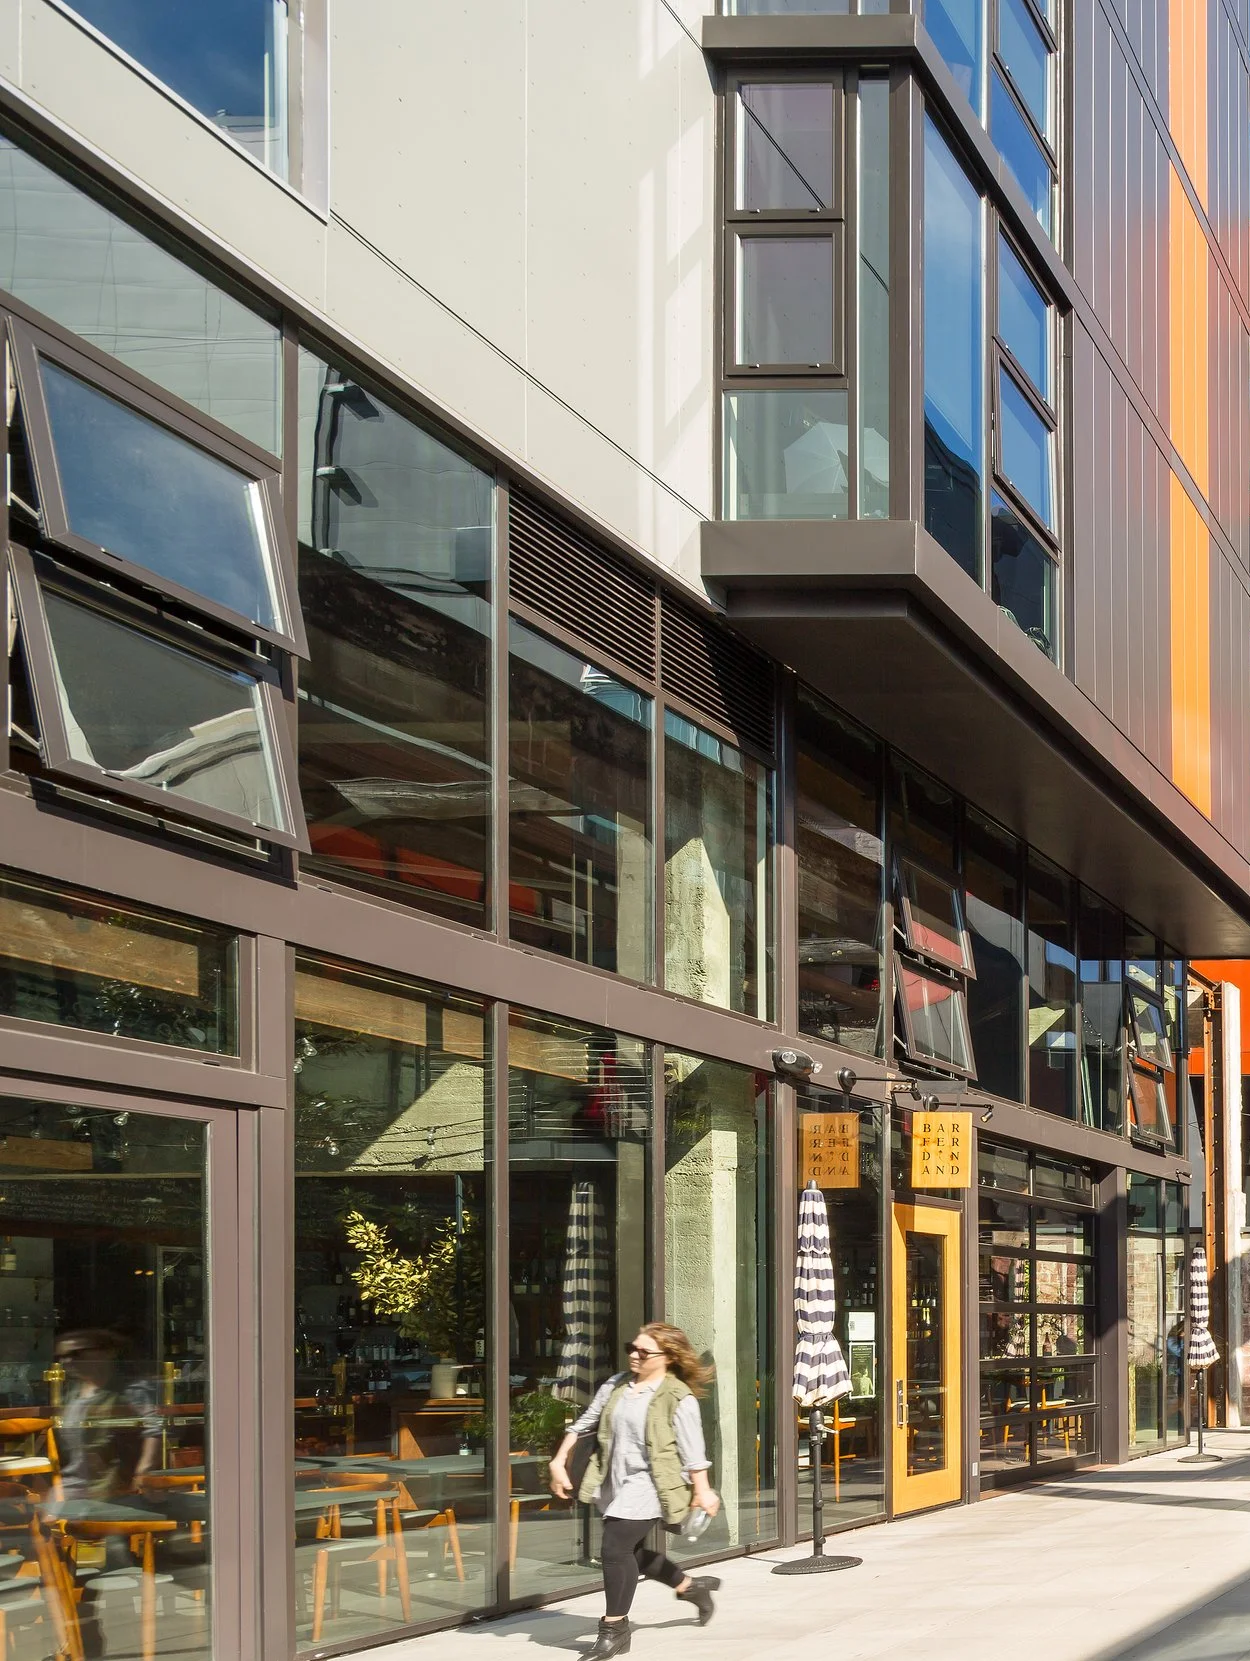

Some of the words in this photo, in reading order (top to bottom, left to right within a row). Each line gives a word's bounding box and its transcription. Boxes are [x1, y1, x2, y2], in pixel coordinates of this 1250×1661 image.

[923, 1123, 960, 1133] BAR
[922, 1137, 960, 1147] FER
[921, 1165, 960, 1175] AND
